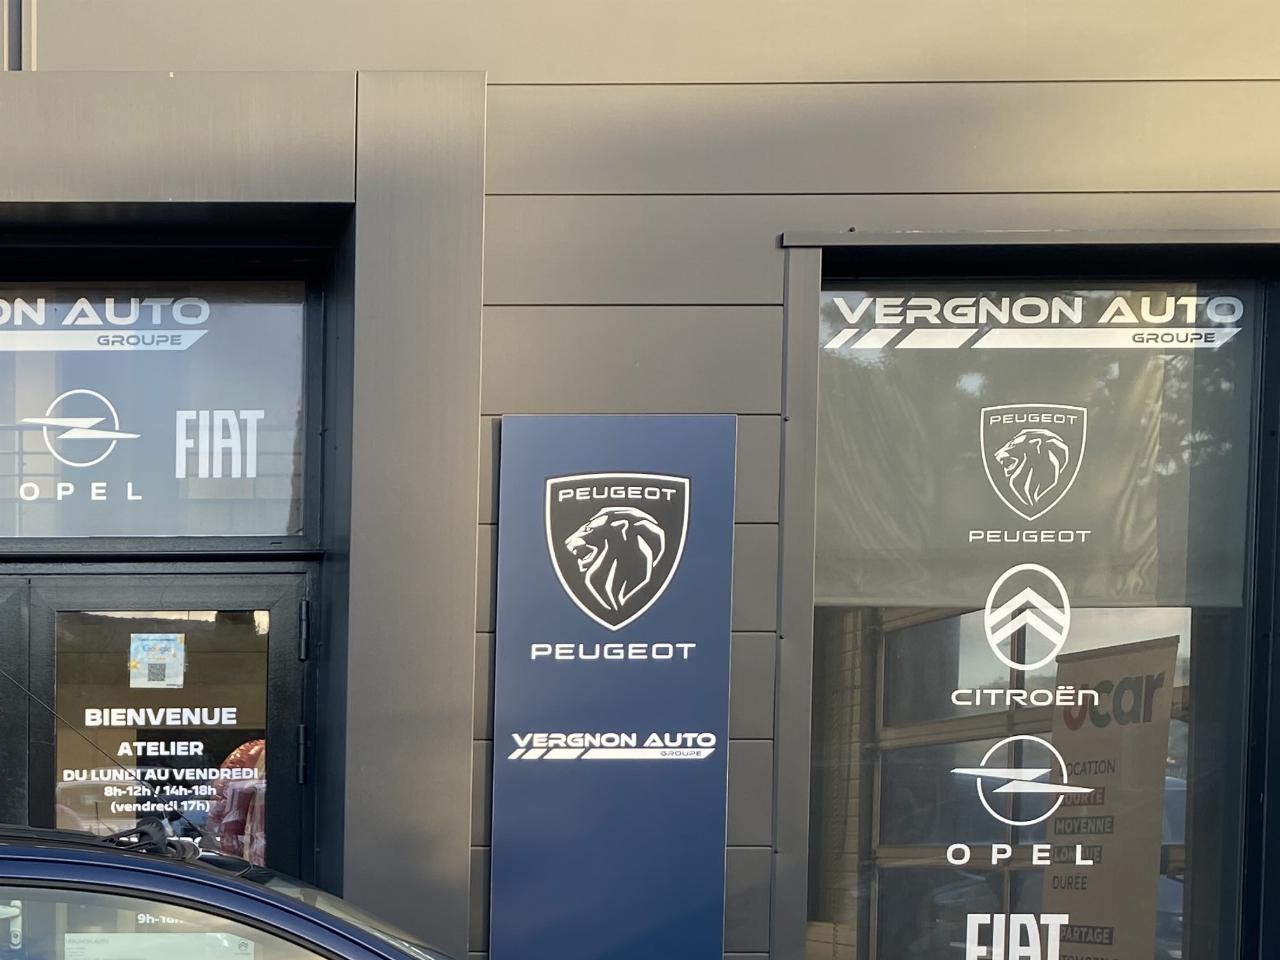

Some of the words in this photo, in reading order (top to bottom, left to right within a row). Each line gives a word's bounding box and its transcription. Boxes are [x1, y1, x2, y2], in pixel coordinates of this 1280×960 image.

[61, 297, 211, 326] AUTO
[832, 297, 1083, 324] VERGNON
[1097, 296, 1244, 324] AUTO
[96, 334, 183, 347] GROUPE
[1131, 332, 1216, 344] GROUPE
[989, 413, 1078, 425] PEUGEOT
[175, 410, 265, 479] FIAT
[19, 482, 142, 502] OPEL
[558, 486, 677, 502] PEUGEOT
[969, 529, 1092, 543] PEUGEOT
[531, 643, 697, 660] PEUGEOT
[950, 686, 1100, 706] CITROËN
[84, 707, 237, 726] BIENVENUE
[511, 732, 637, 748] VERGNON
[643, 732, 717, 748] AUTO
[117, 741, 205, 757] ATELIER
[63, 769, 88, 781] DU
[91, 769, 141, 781] LUNDI
[144, 768, 170, 780] AU
[172, 768, 258, 780] VENDREDI
[104, 785, 151, 797] 8h-12h
[163, 785, 217, 796] 14h-18h
[1058, 788, 1103, 805] OURTE
[110, 801, 178, 813] (vendredi
[181, 800, 210, 812] 17h)
[1055, 818, 1113, 833] MOYENNE
[946, 844, 1094, 866] OPEL
[1054, 846, 1101, 863] LONUE
[1052, 872, 1087, 890] DURÉE
[1060, 926, 1111, 944] PARTAGE
